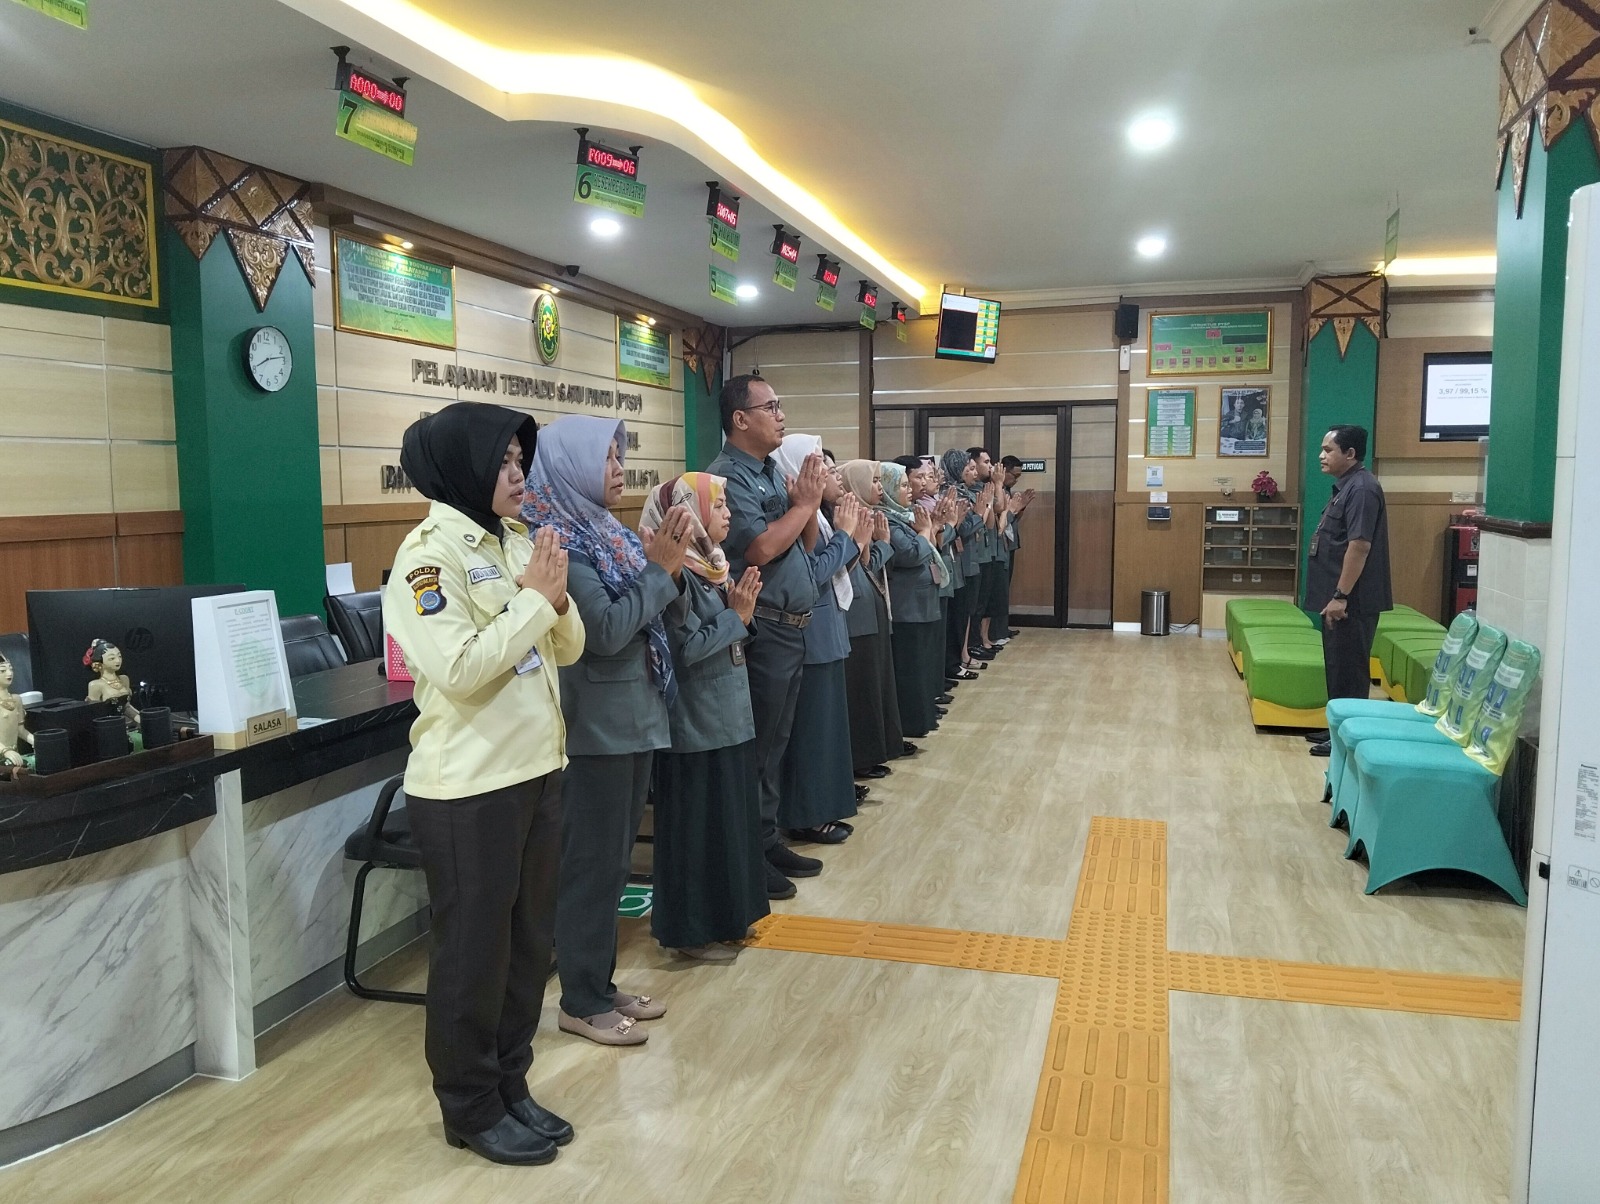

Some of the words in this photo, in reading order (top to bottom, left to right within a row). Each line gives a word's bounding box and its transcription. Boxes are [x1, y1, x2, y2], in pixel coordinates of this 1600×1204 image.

[342, 98, 358, 135] 7
[578, 171, 592, 199] 6
[711, 222, 718, 247] 5
[710, 270, 717, 293] 5
[775, 260, 783, 281] 4
[411, 358, 497, 394] PELAYANAN
[499, 373, 556, 400] TERPADU
[557, 382, 585, 404] SATU
[585, 387, 614, 408] PINTU
[1459, 387, 1479, 395] 99,15
[1026, 462, 1044, 470] PETUGAS
[409, 567, 437, 580] POLDA
[253, 717, 282, 734] SALASA
